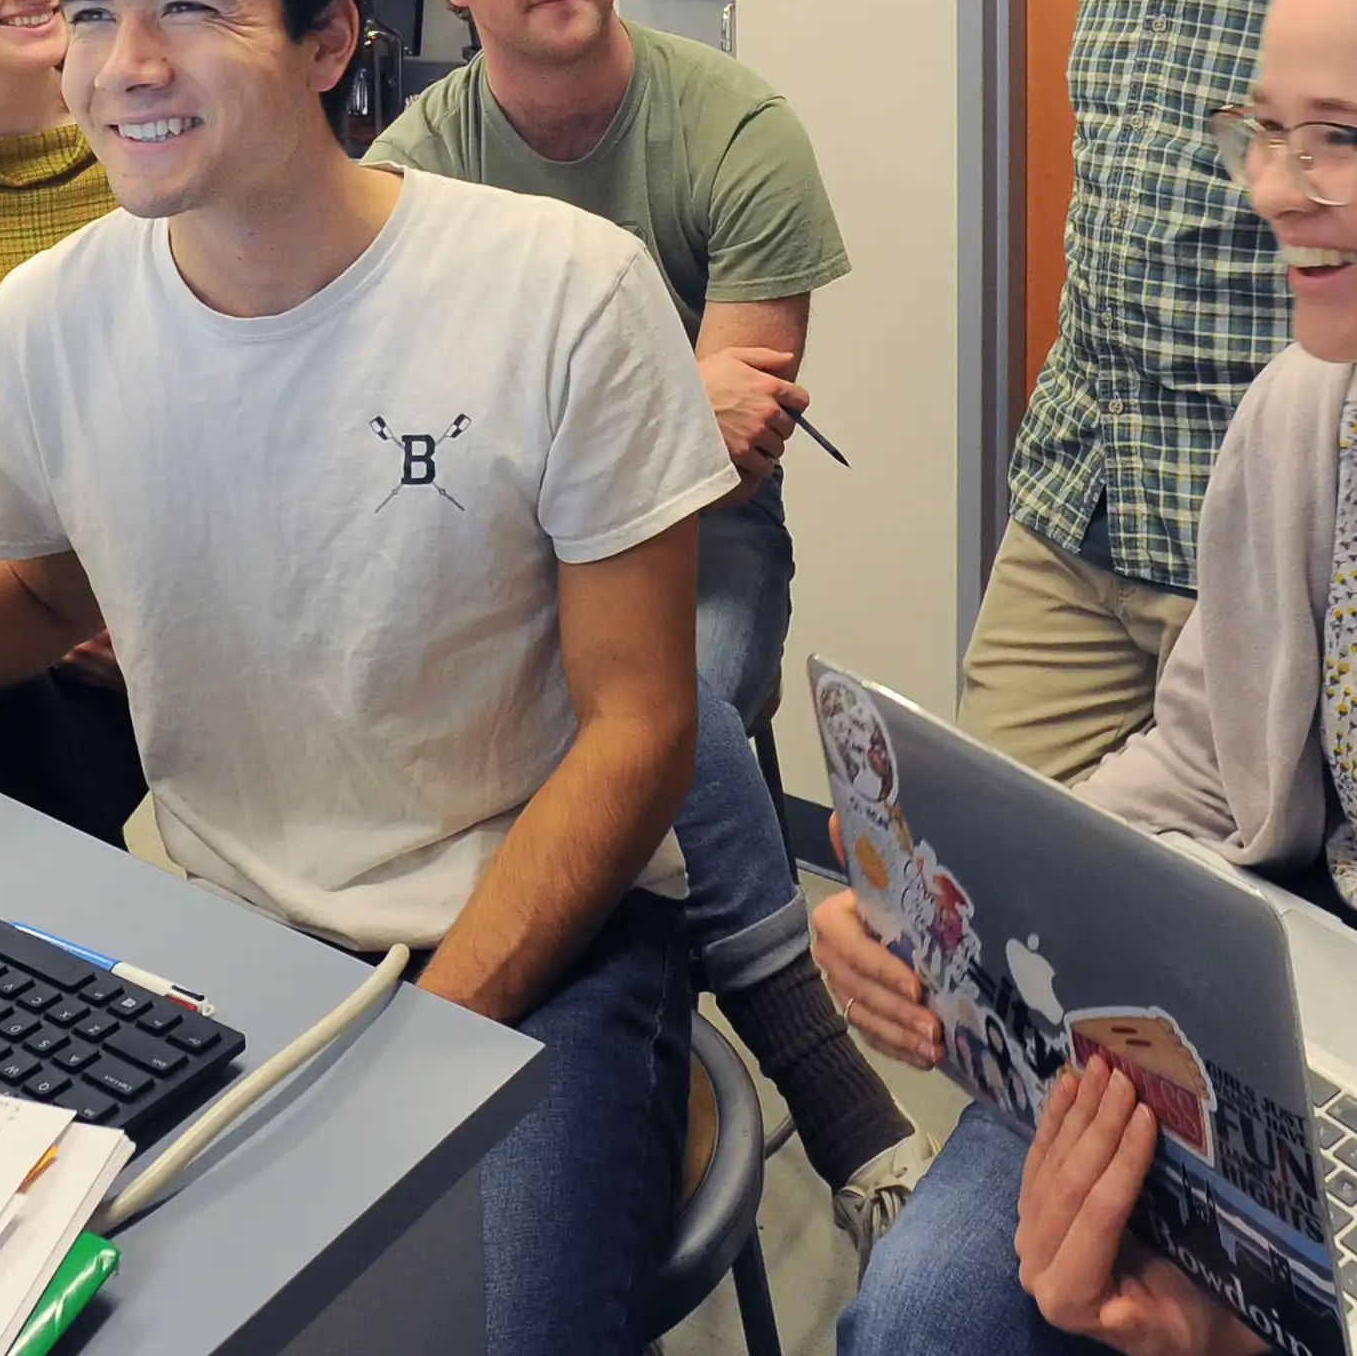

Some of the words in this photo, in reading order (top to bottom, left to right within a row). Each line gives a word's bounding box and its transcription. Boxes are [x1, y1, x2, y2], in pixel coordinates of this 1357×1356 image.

[401, 434, 436, 484] B
[1215, 1097, 1318, 1201] FUN
[1262, 1097, 1306, 1135] JUST
[1220, 1157, 1325, 1244] RIGHTS
